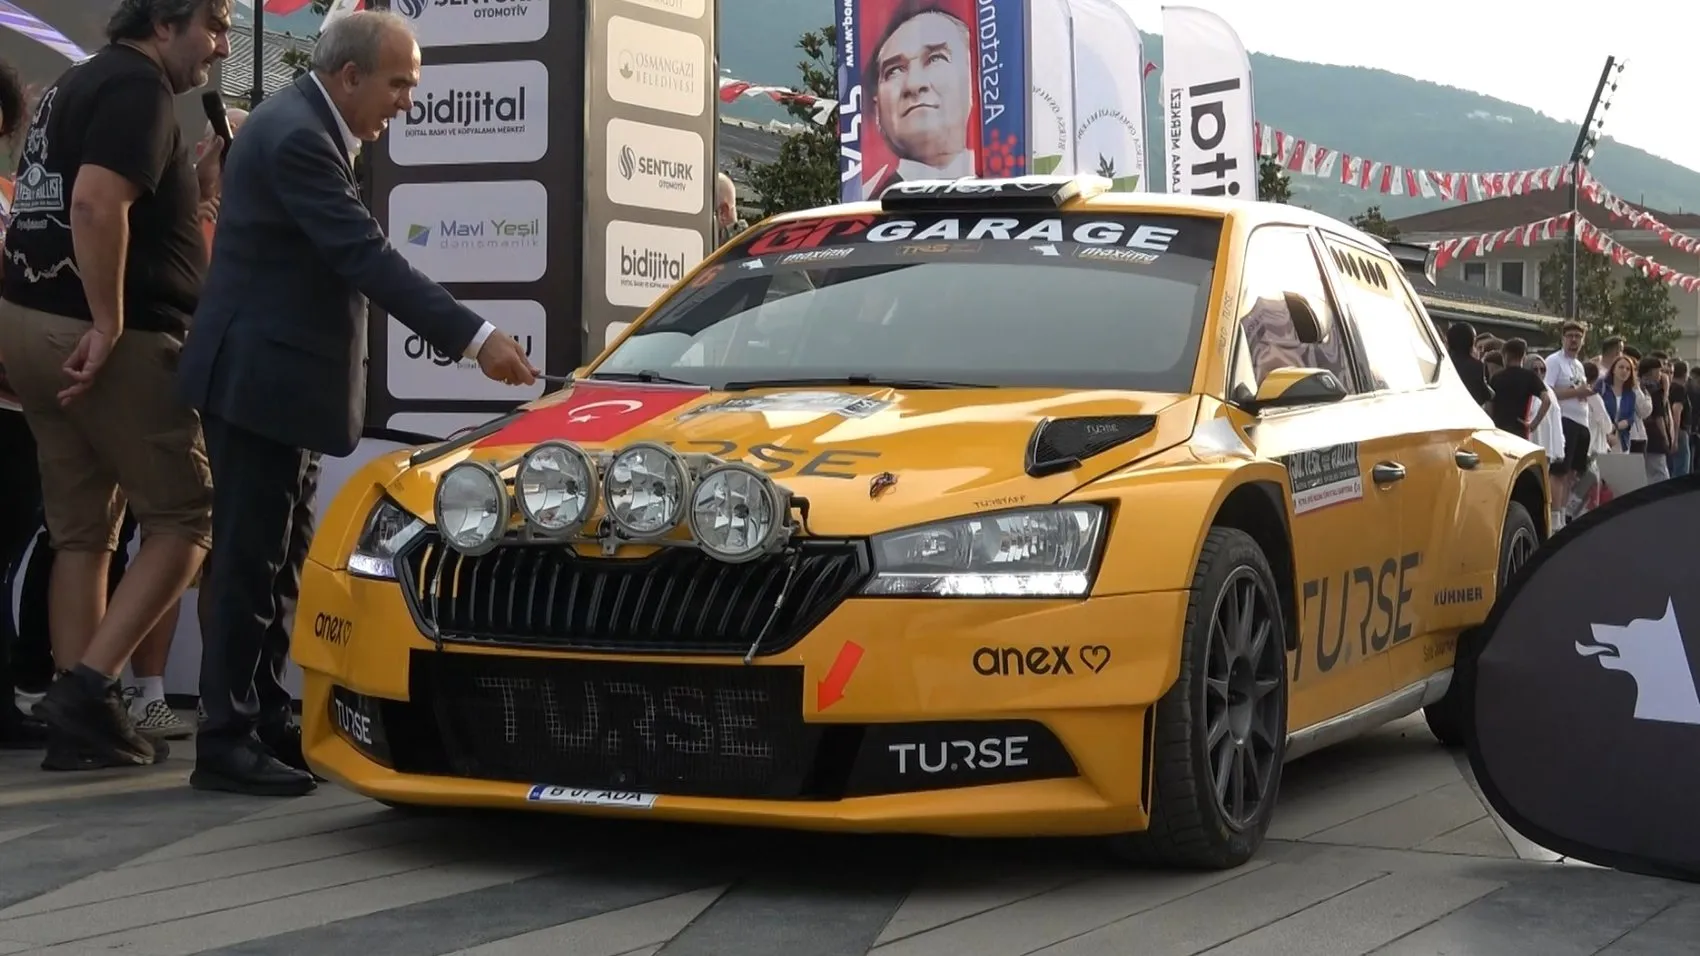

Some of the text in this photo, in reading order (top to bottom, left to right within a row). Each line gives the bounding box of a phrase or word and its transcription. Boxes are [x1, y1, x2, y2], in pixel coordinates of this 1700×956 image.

[406, 86, 525, 126] bidijital
[866, 218, 1179, 251] GARAGE
[621, 245, 684, 281] bidijital
[315, 612, 344, 645] anex
[973, 645, 1074, 676] anex
